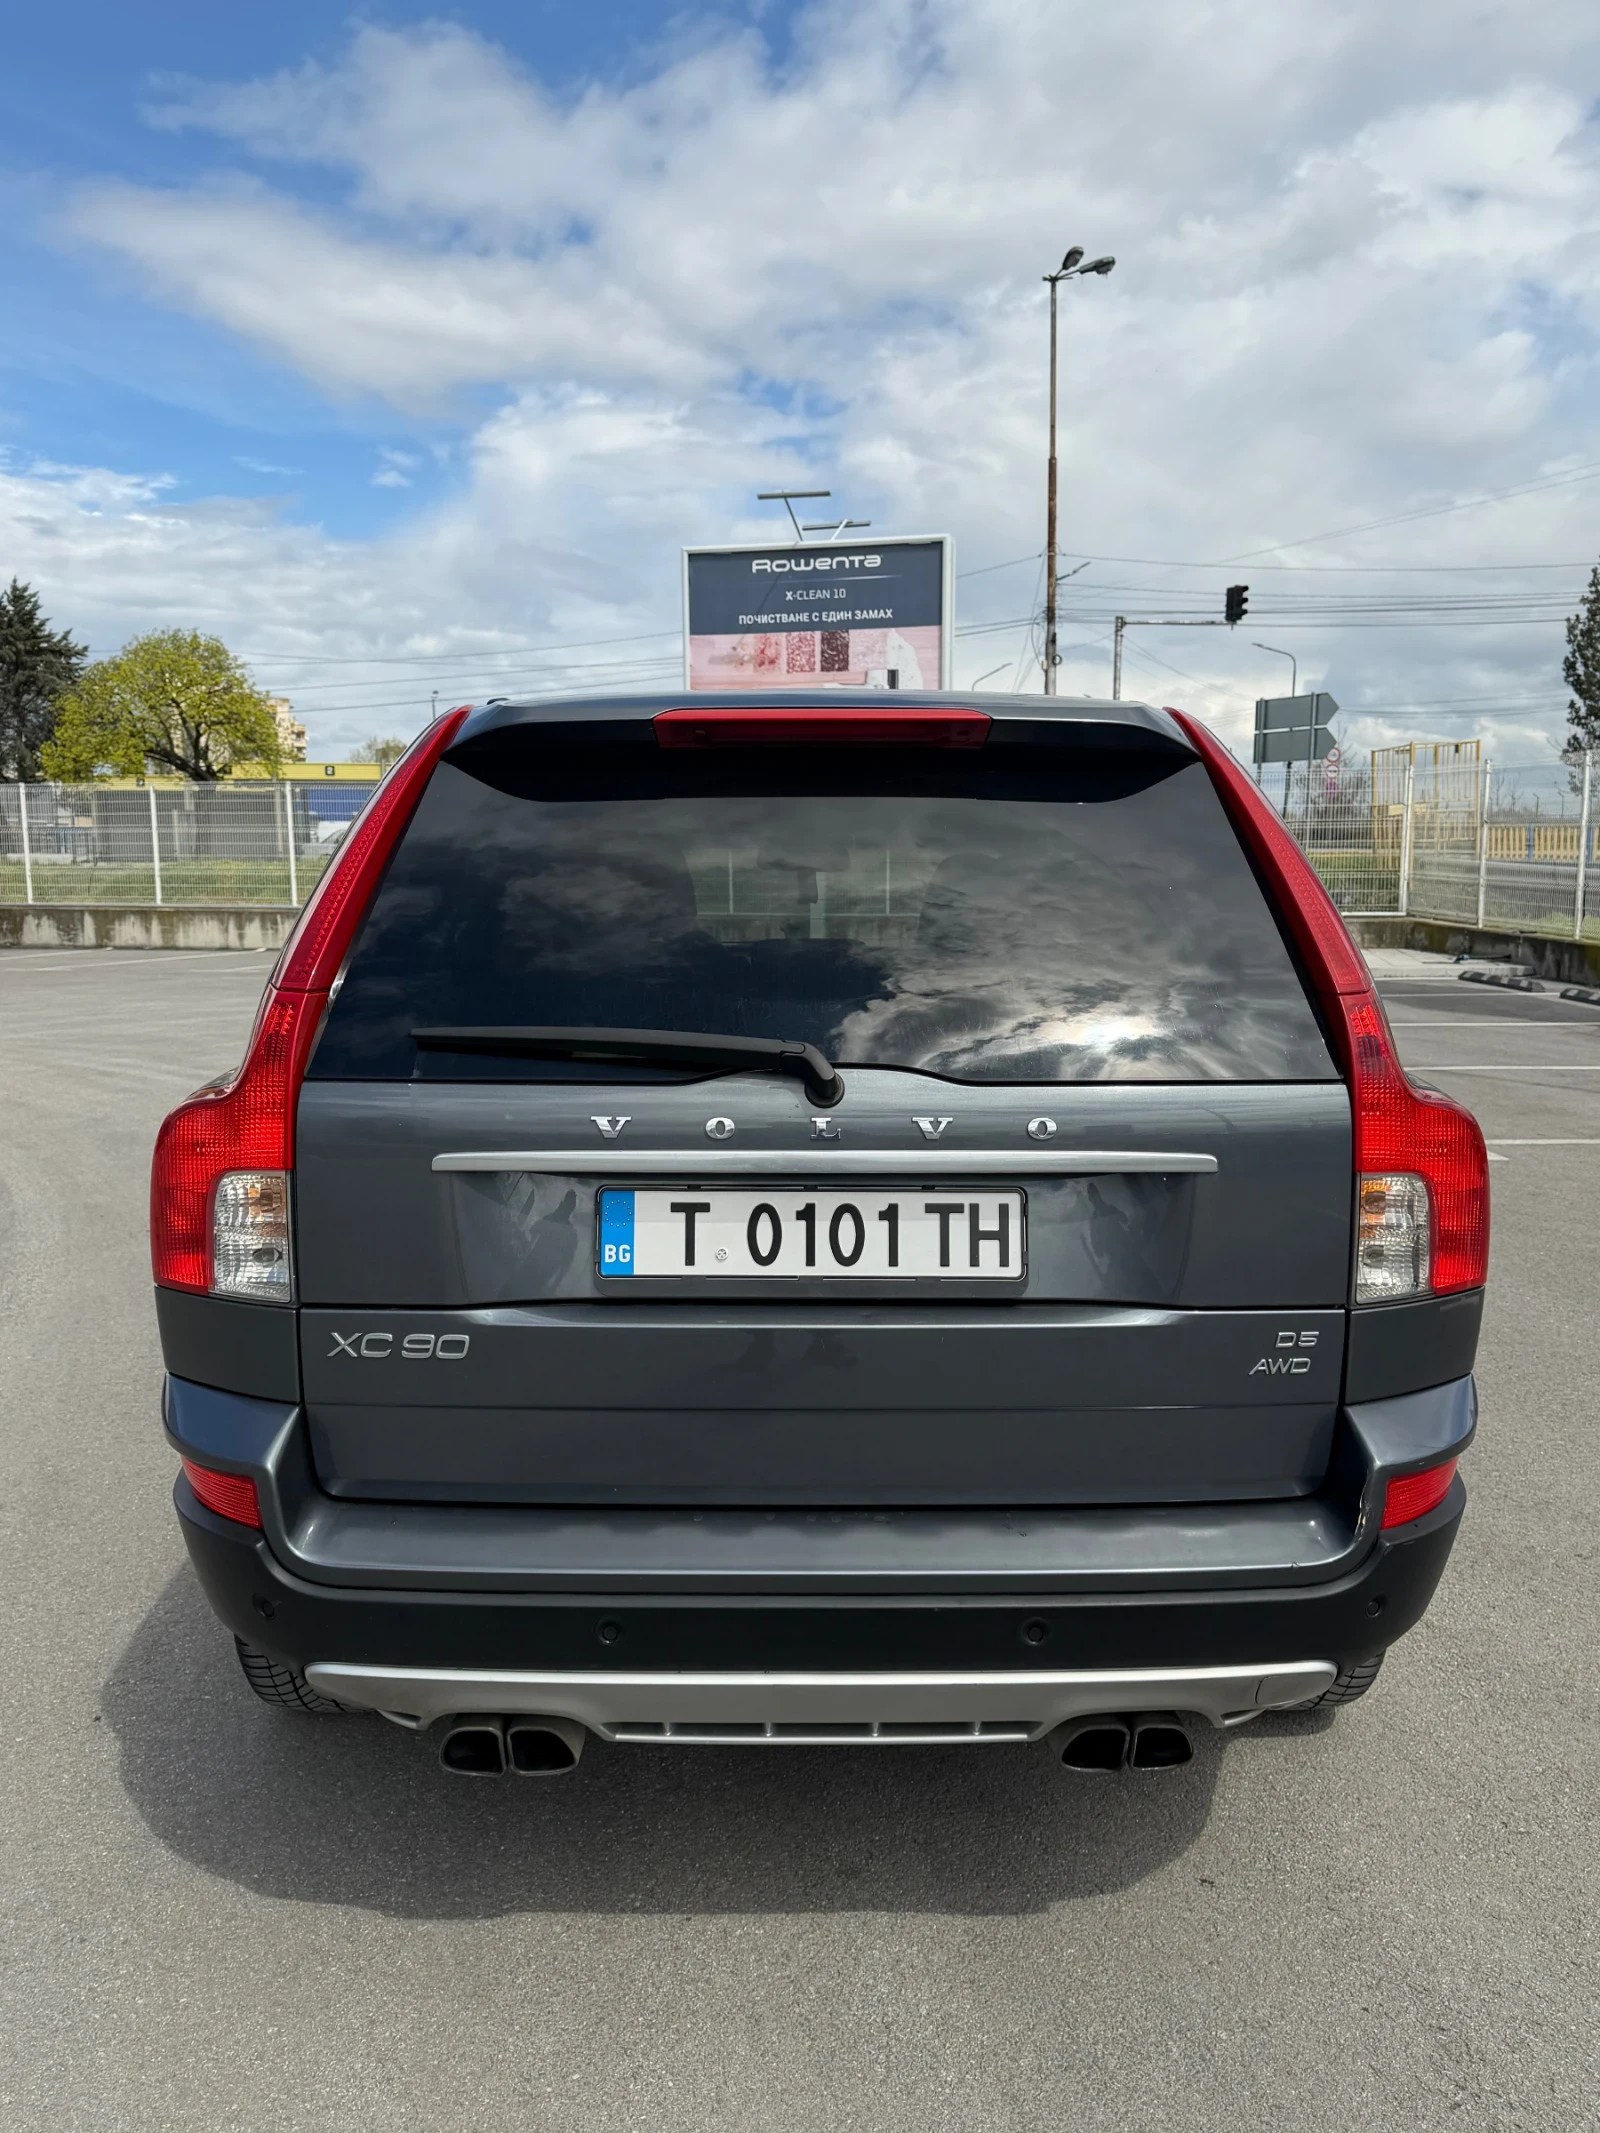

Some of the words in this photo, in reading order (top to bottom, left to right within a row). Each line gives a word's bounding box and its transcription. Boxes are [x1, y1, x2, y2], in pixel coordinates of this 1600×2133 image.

[785, 590, 830, 601] X-CLEAN
[833, 588, 846, 599] 10
[739, 612, 810, 625] ПОЧИСТВАНЕ
[812, 612, 819, 622] С
[822, 610, 852, 622] ЕДИН
[854, 609, 893, 620] ЗАМАХ
[590, 1115, 1058, 1140] VOLVO
[670, 1202, 711, 1267] T
[746, 1202, 899, 1268] 0101
[925, 1202, 1010, 1268] TH
[604, 1244, 631, 1263] BG
[1275, 1331, 1320, 1348] D5
[1249, 1357, 1311, 1375] AWD
